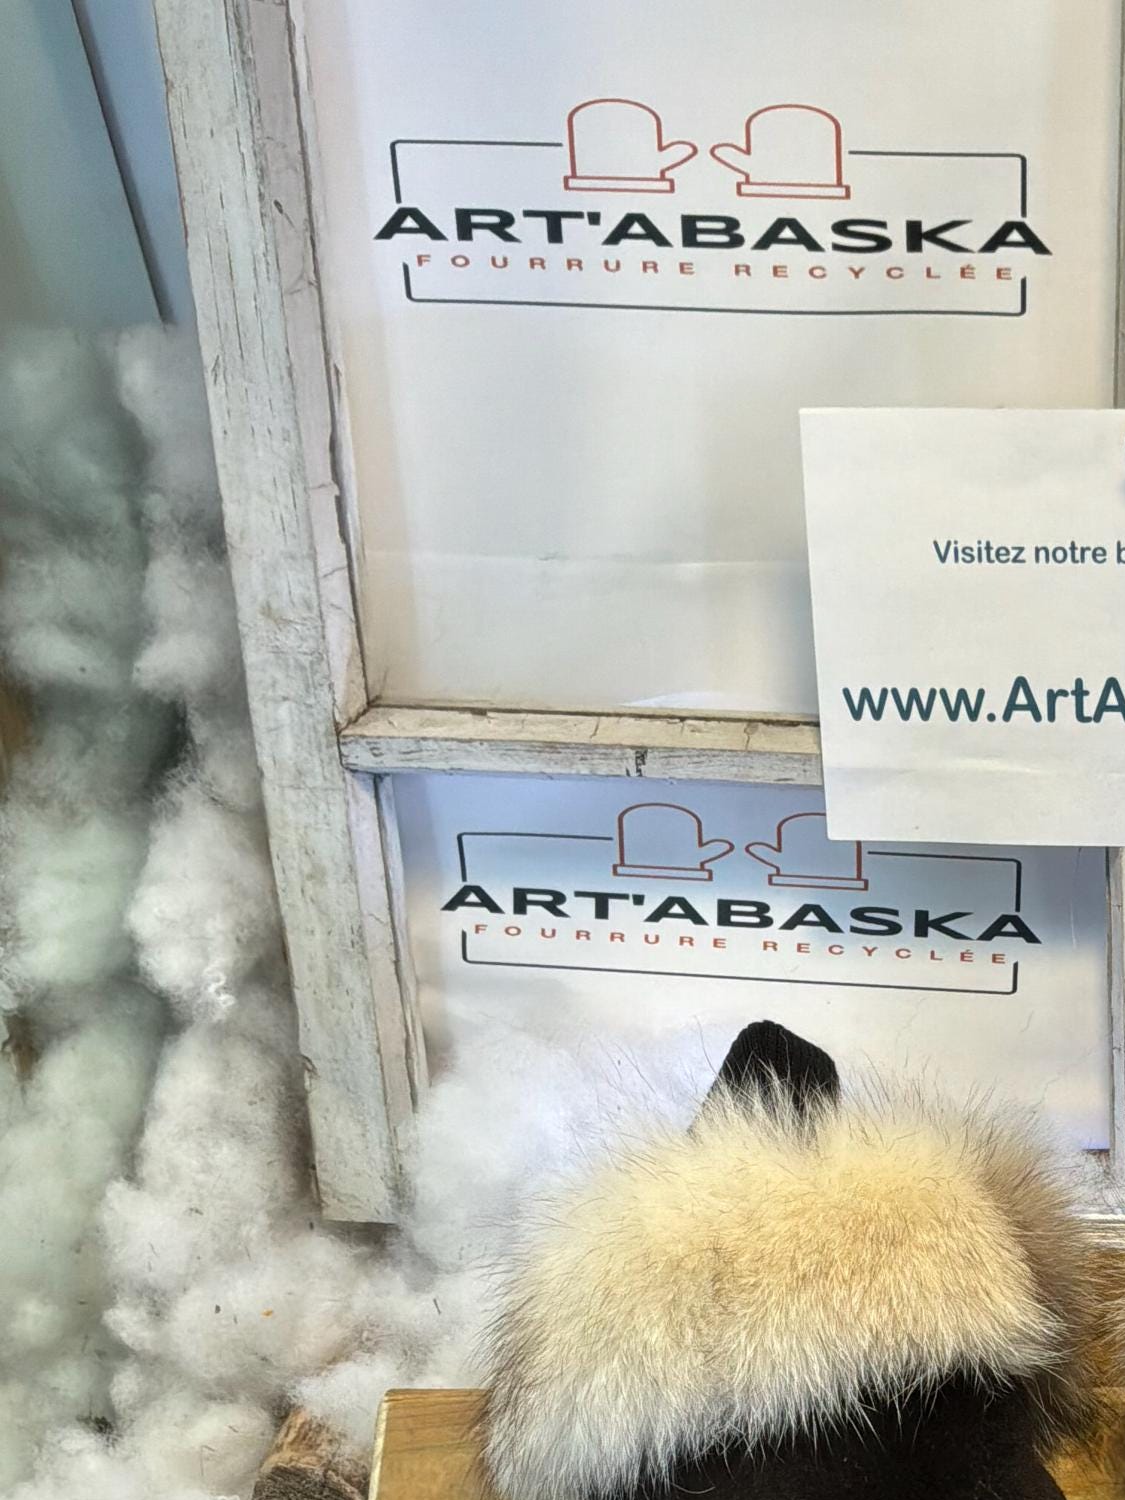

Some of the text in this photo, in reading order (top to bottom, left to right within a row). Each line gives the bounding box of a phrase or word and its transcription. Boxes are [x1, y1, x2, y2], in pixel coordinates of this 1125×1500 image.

[374, 207, 1052, 255] ART'ABASKA
[416, 253, 1012, 283] FOURRURE RECYCLÉE
[933, 540, 1026, 565] Visitez
[1034, 540, 1107, 565] notre
[441, 884, 1042, 945] ART'ABASKA
[474, 922, 1006, 966] FOURRURE RECYCLÉE
